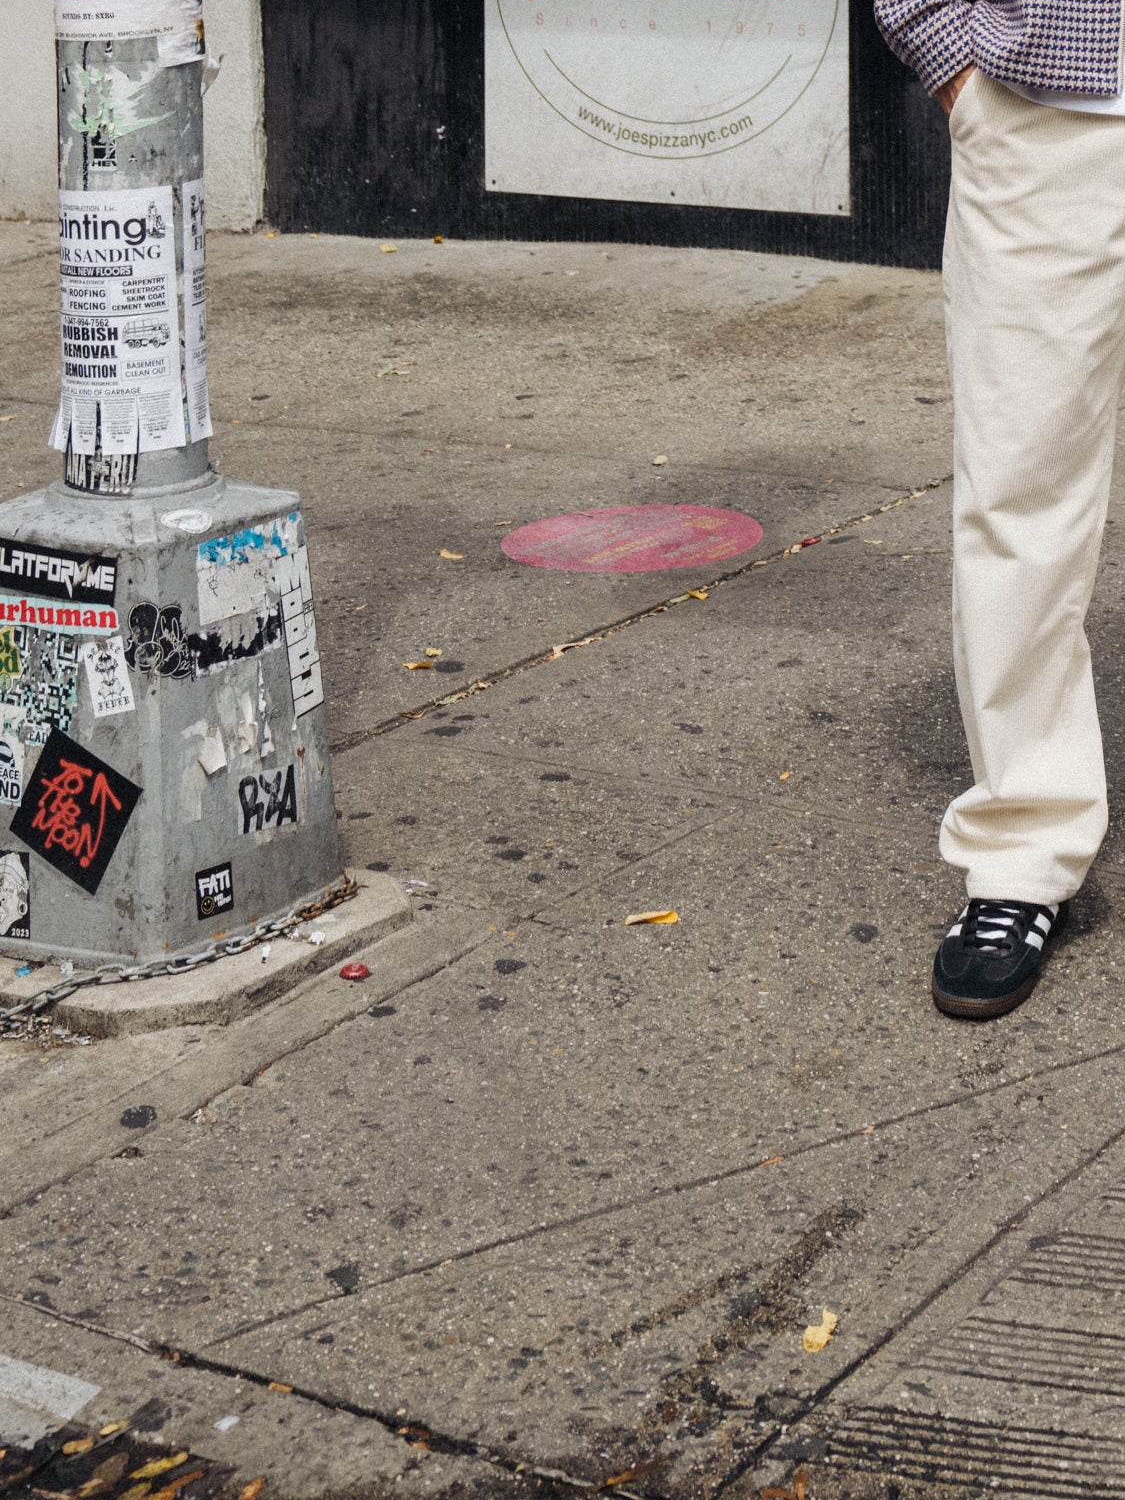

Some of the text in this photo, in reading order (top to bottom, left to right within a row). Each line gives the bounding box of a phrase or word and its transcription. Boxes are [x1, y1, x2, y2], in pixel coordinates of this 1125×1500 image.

[578, 104, 754, 148] www.joespizzanyc.com
[74, 244, 162, 263] SANDING
[77, 266, 96, 276] NEW
[96, 266, 131, 276] FLOORS
[122, 277, 165, 287] CARPENTRY
[69, 288, 106, 298] ROOFING
[122, 286, 165, 295] SHEETROCK
[126, 293, 166, 303] SKIM COAT
[69, 301, 106, 311] FENCING
[112, 301, 166, 312] CEMENT WORK
[63, 324, 118, 341] RUBBISH
[63, 343, 118, 359] REMOVAL
[127, 359, 165, 370] BASEMENT
[65, 362, 117, 378] DEMOLITION
[125, 367, 167, 378] CLEAN OUT
[104, 387, 141, 395] GARBAGE
[11, 928, 30, 938] 2023
